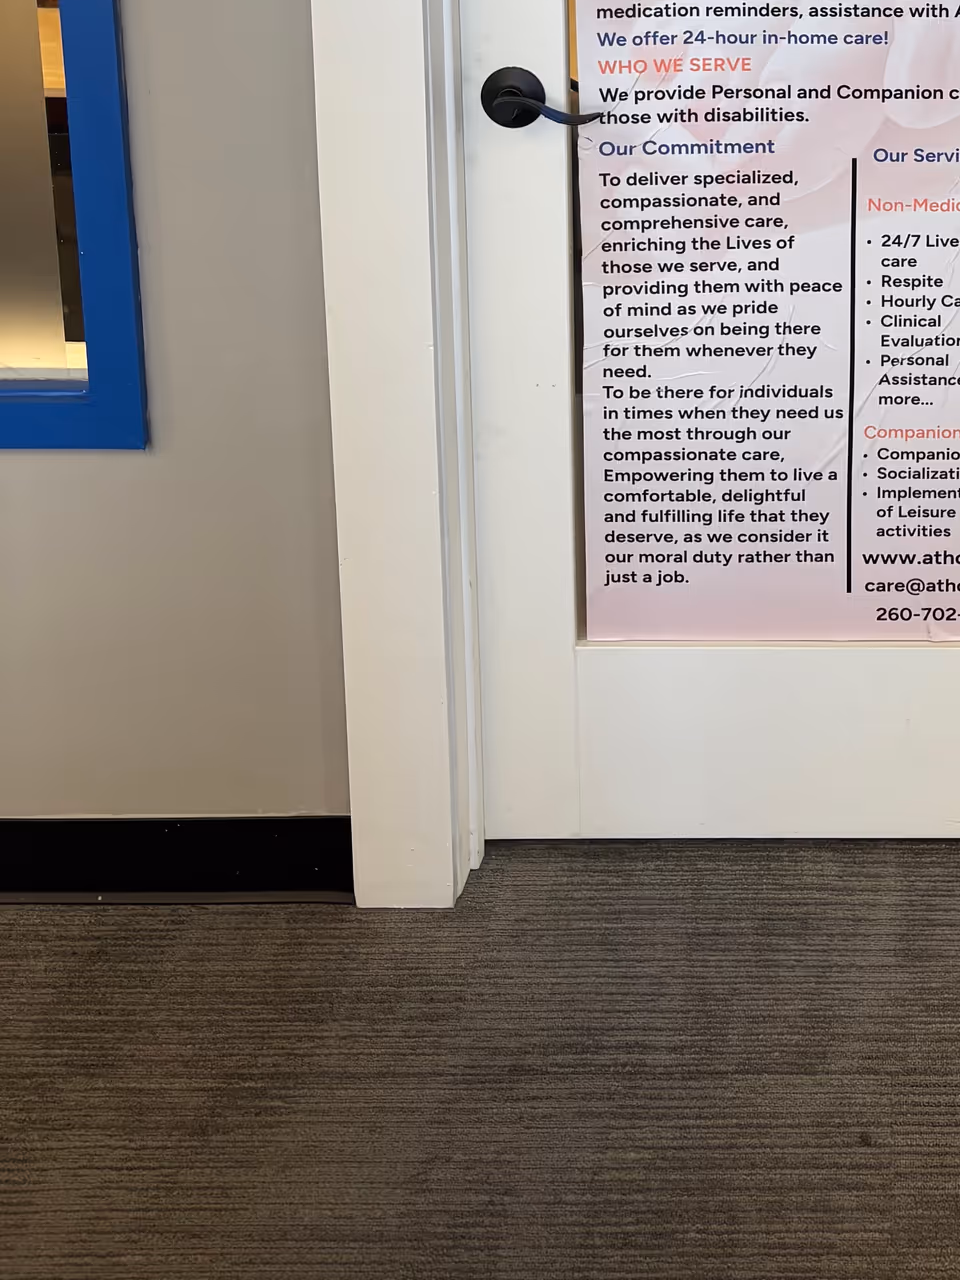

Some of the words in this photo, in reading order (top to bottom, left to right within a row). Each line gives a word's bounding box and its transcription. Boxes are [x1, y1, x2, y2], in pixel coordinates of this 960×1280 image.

[596, 32, 627, 47] We
[631, 30, 678, 47] offer
[682, 29, 758, 45] 24-hour
[762, 29, 839, 45] in-home
[843, 30, 889, 45] care!
[597, 59, 648, 75] WHO
[652, 57, 684, 74] WE
[689, 57, 752, 72] SERVE
[598, 110, 652, 125] those
[656, 107, 699, 124] with
[703, 106, 810, 123] disabilities.
[598, 141, 638, 157] Our
[642, 138, 776, 156] Commitment
[873, 148, 909, 163] Our
[598, 172, 621, 187] To
[625, 171, 689, 187] deliver
[693, 169, 799, 189] specialized,
[600, 192, 743, 212] compassionate,
[747, 191, 781, 206] and
[600, 214, 740, 234] comprehensive
[744, 217, 789, 230] care,
[601, 236, 686, 255] enriching
[690, 236, 721, 251] the
[726, 235, 772, 250] Lives
[776, 235, 795, 250] of
[881, 233, 921, 249] 24/7
[925, 234, 960, 248] Live
[880, 257, 918, 268] care
[881, 274, 944, 291] Respite
[881, 294, 937, 311] Hourly
[880, 314, 942, 328] Clinical
[880, 353, 949, 367] Personal
[878, 395, 934, 406] more...
[603, 447, 737, 465] compassionate
[741, 450, 785, 463] care,
[603, 488, 717, 504] comfortable,
[721, 488, 806, 506] delightful
[876, 505, 894, 518] of
[898, 505, 957, 519] Leisure
[876, 524, 951, 538] activities
[603, 569, 638, 587] just
[642, 573, 653, 583] a
[655, 569, 690, 587] job.
